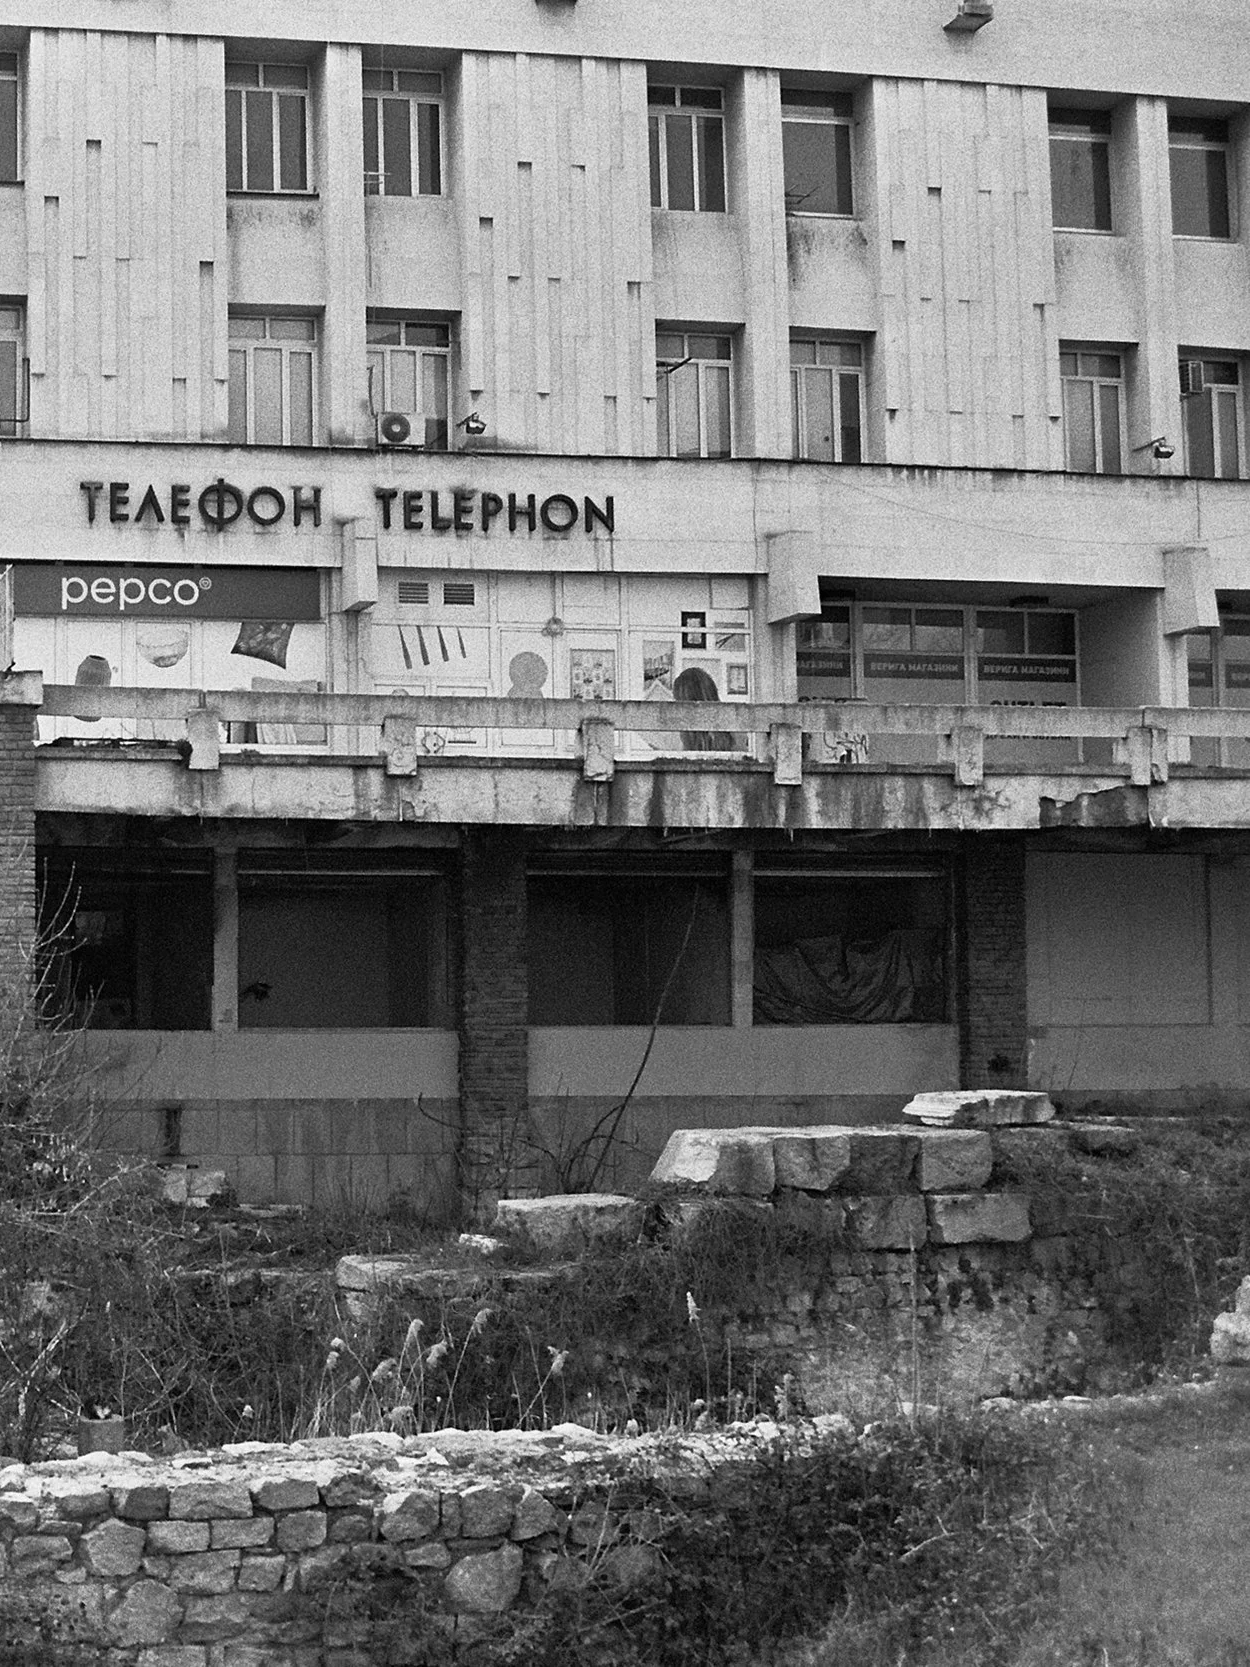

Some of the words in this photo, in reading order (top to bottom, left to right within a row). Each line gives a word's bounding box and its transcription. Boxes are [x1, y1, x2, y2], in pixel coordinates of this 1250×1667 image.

[80, 477, 322, 532] ТЕЛЕФОН
[374, 486, 616, 533] TELEPHON
[61, 577, 200, 611] pepco
[870, 661, 907, 671] ВЕРИГА
[908, 663, 959, 673] МАГАЗИНИ
[983, 664, 1019, 674] ВЕРИГА
[1021, 665, 1070, 675] МАГАЗИНИ
